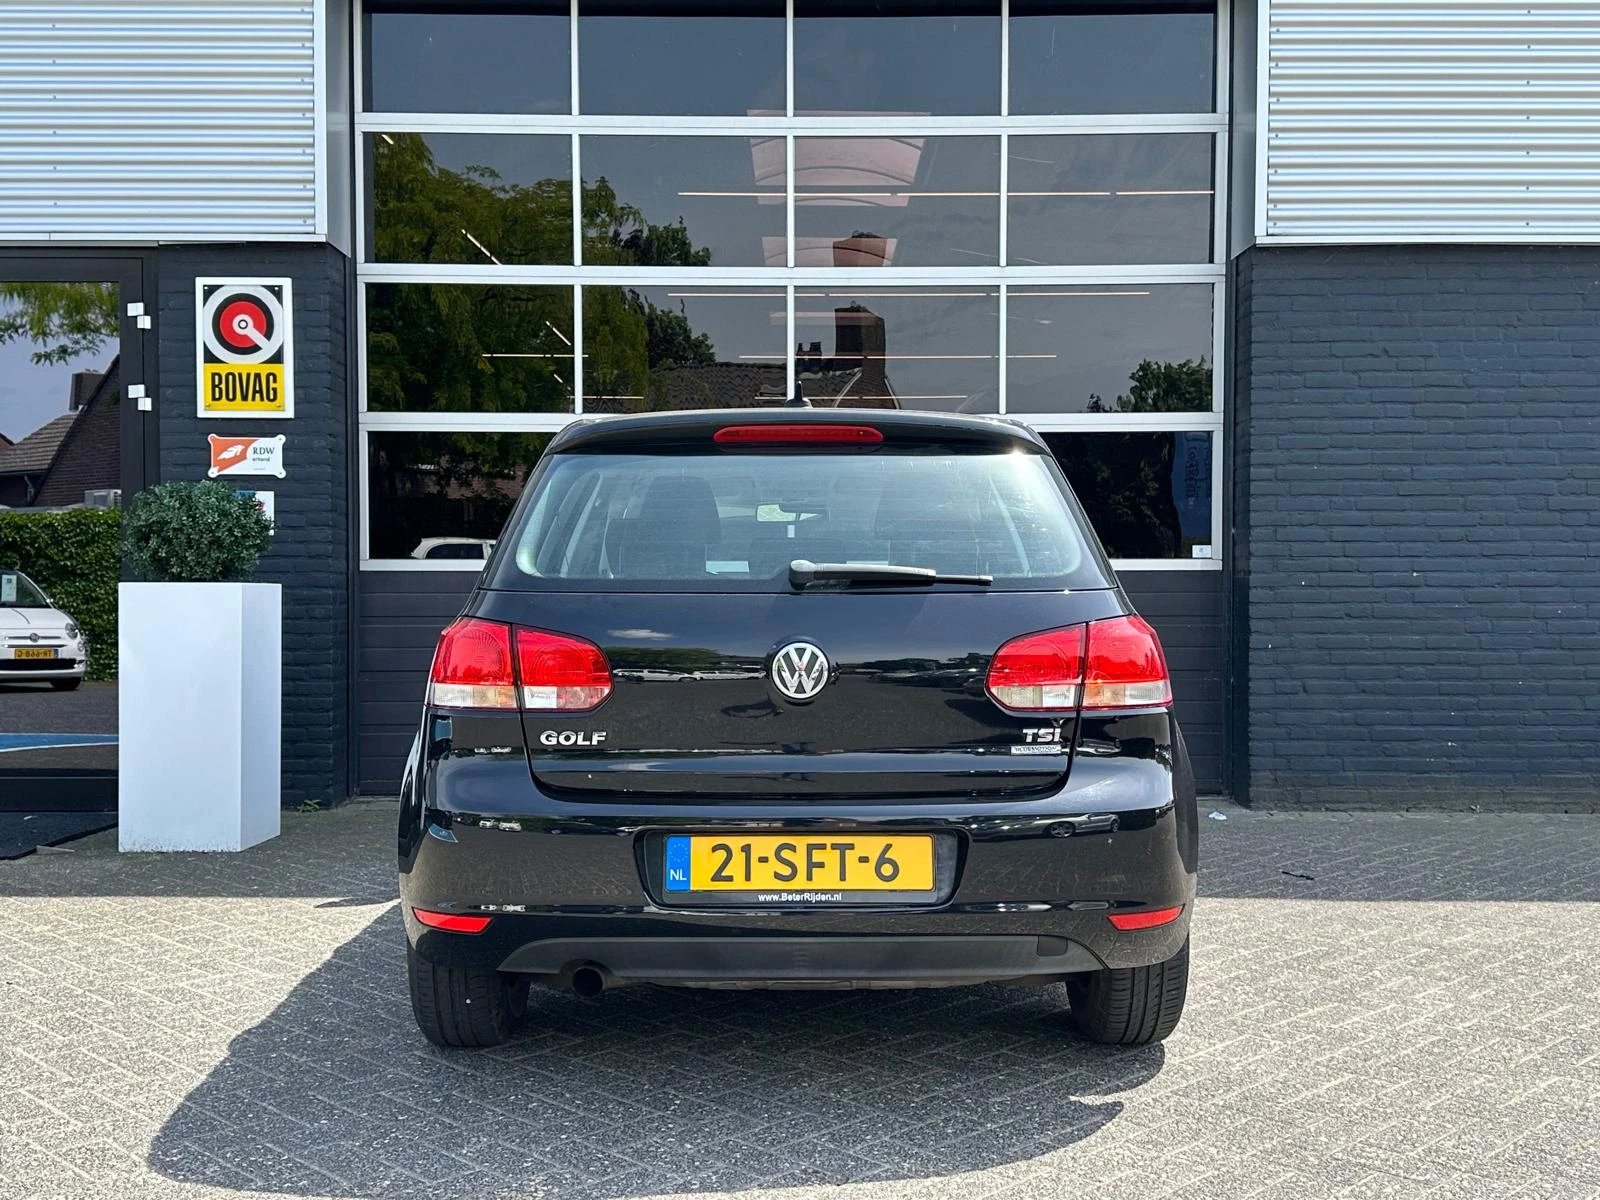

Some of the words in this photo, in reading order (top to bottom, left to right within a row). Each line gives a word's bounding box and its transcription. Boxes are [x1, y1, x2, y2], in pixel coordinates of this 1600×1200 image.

[210, 371, 278, 403] BOVAG
[252, 447, 275, 455] RDW
[539, 730, 607, 747] GOLF
[1022, 727, 1061, 743] TSI
[669, 868, 687, 882] NL
[710, 842, 900, 883] 21-SFT-6
[757, 892, 842, 903] www.BeterRijden.nl
